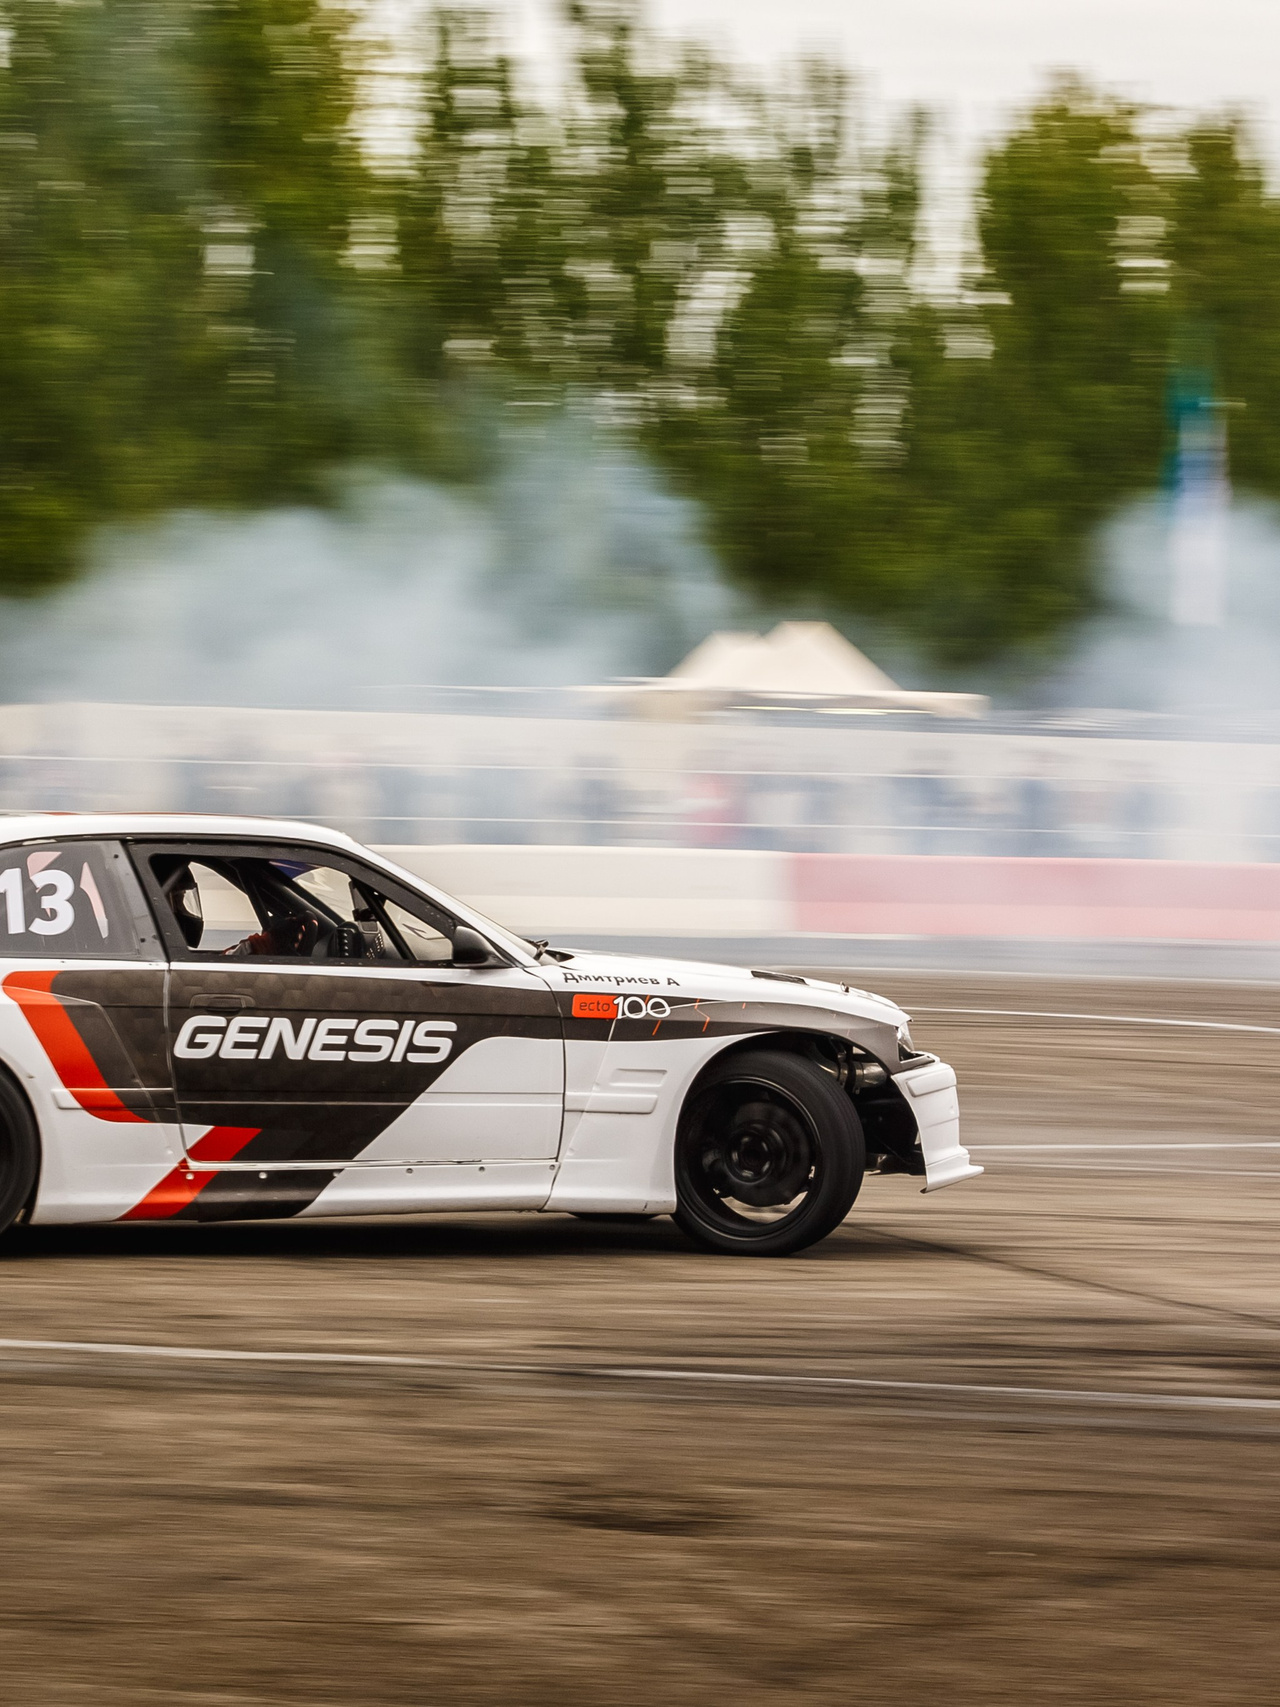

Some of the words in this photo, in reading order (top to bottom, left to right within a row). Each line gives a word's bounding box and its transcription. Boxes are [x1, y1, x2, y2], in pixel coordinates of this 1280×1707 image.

[563, 972, 660, 986] Дмитриев
[667, 977, 680, 987] А
[173, 1015, 457, 1064] GENESIS
